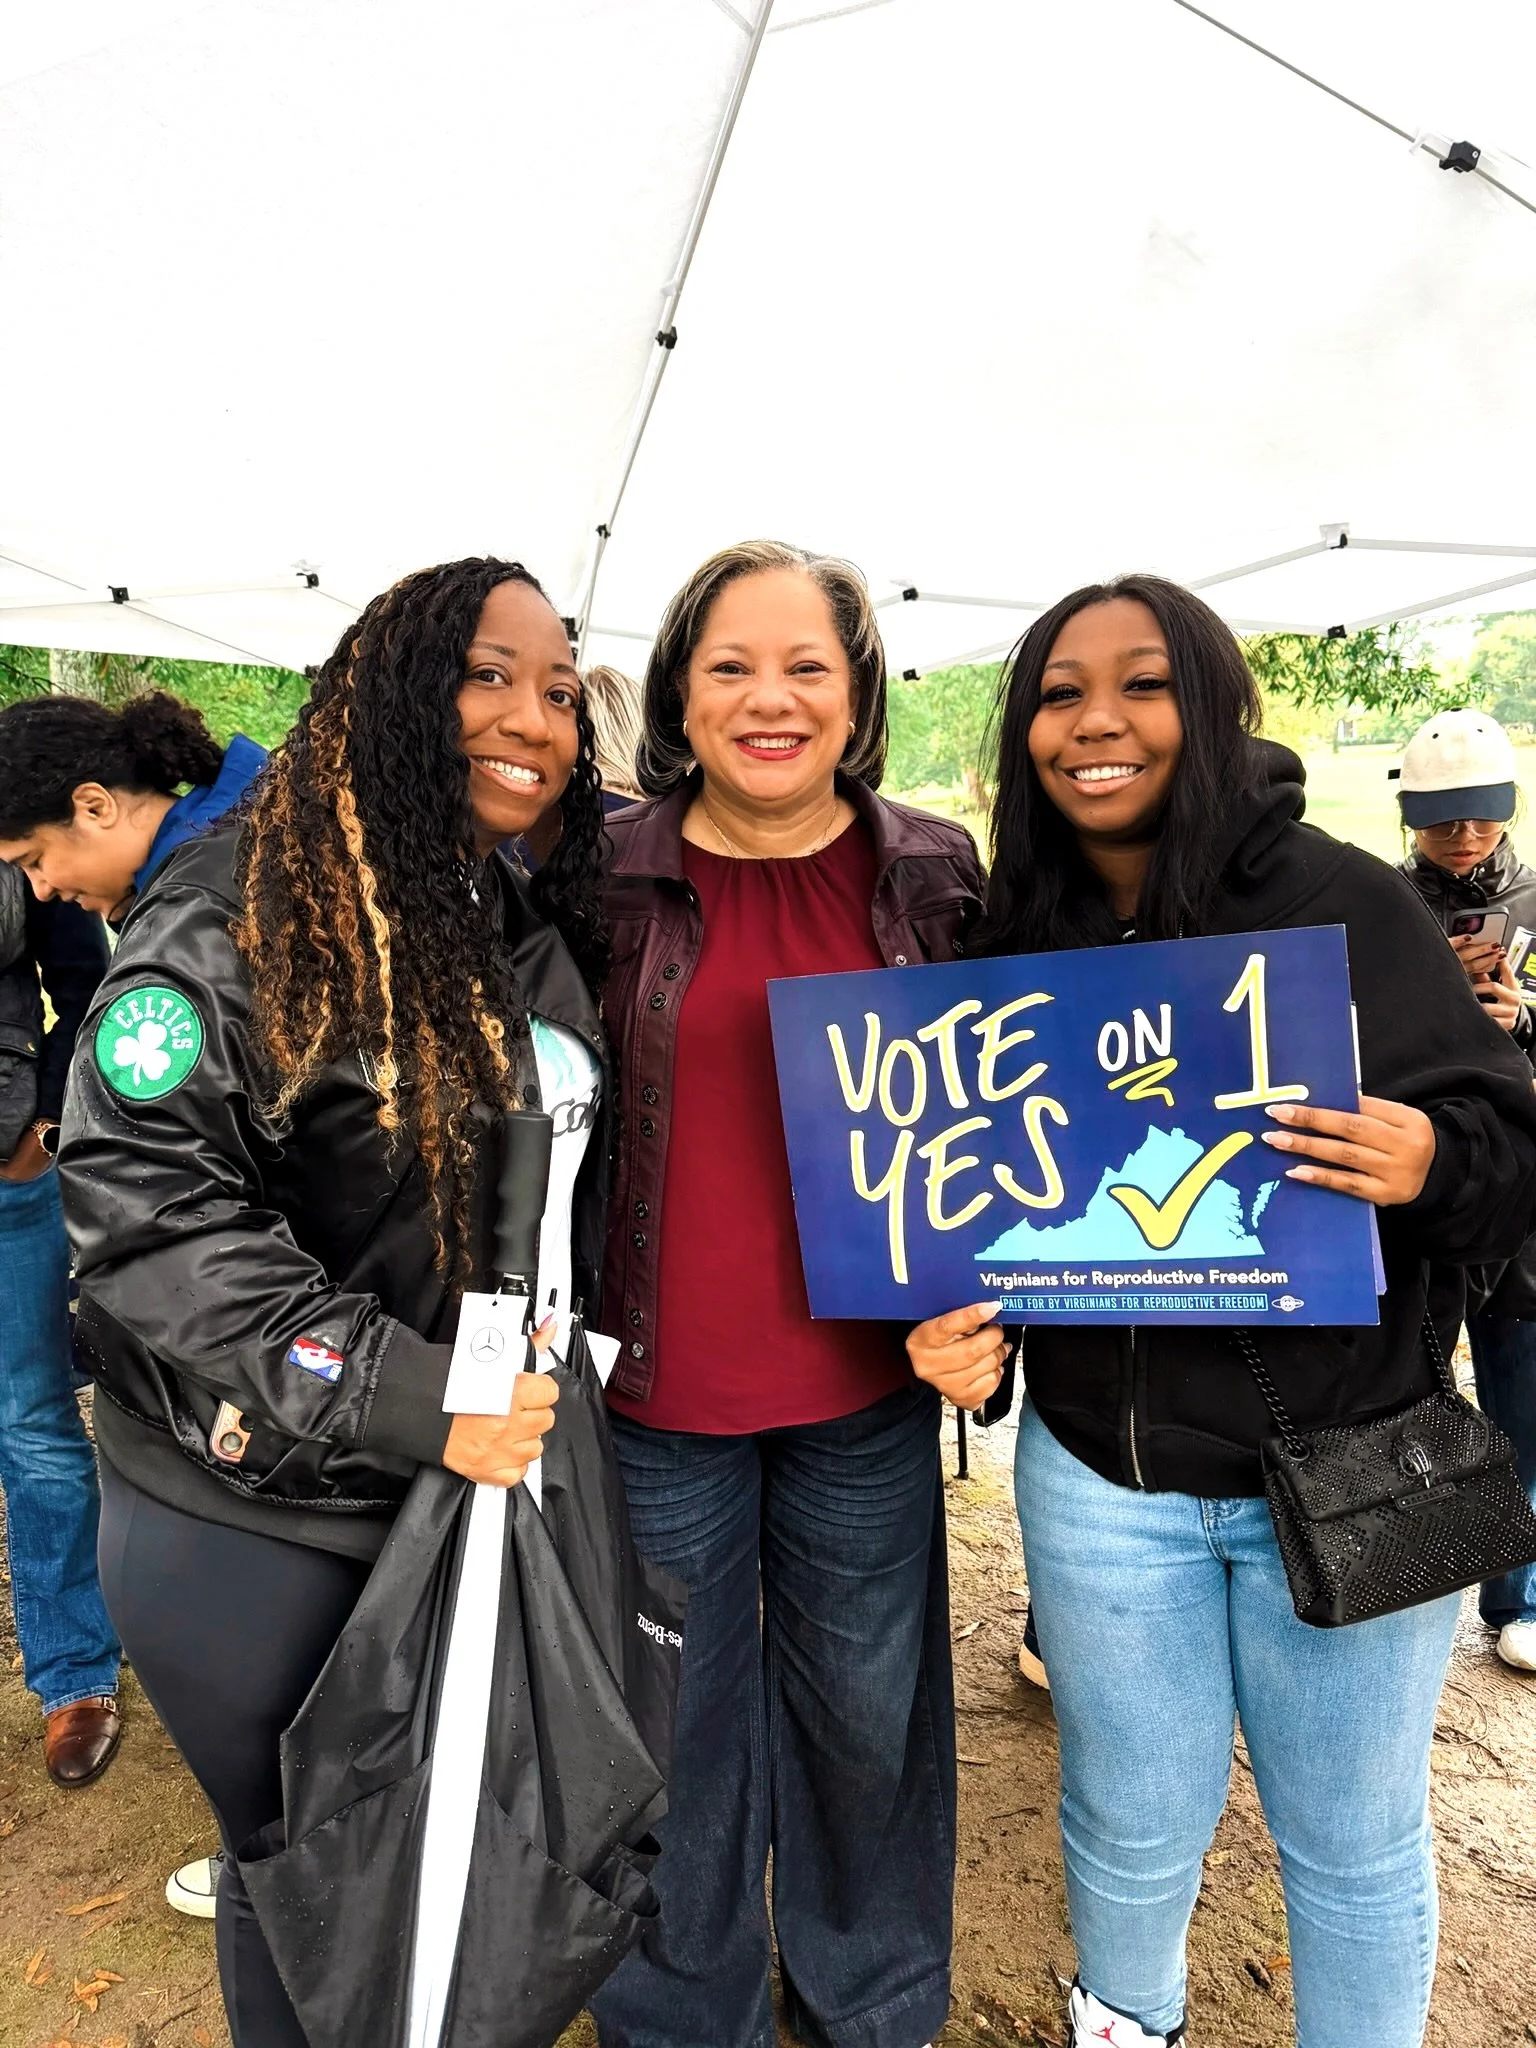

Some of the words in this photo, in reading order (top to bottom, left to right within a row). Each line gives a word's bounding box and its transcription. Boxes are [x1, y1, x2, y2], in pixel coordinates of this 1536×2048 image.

[114, 996, 194, 1050] CELTICS
[826, 992, 1055, 1126] VOTE
[1097, 1003, 1172, 1072] ON
[1215, 953, 1310, 1110] 1
[850, 1096, 1069, 1285] YES
[979, 1272, 1059, 1290] Virginians
[1063, 1271, 1087, 1286] for
[1091, 1269, 1204, 1288] Reproductive
[1209, 1268, 1288, 1284] Freedom
[1003, 1298, 1023, 1309] PAID
[1027, 1298, 1044, 1309] FOR
[1050, 1298, 1060, 1309] BY
[1064, 1297, 1117, 1309] VIRGINIANS
[1122, 1297, 1139, 1309] FOR
[1144, 1296, 1215, 1309] REPRODUCTIVE
[1220, 1296, 1264, 1309] FREEDOM
